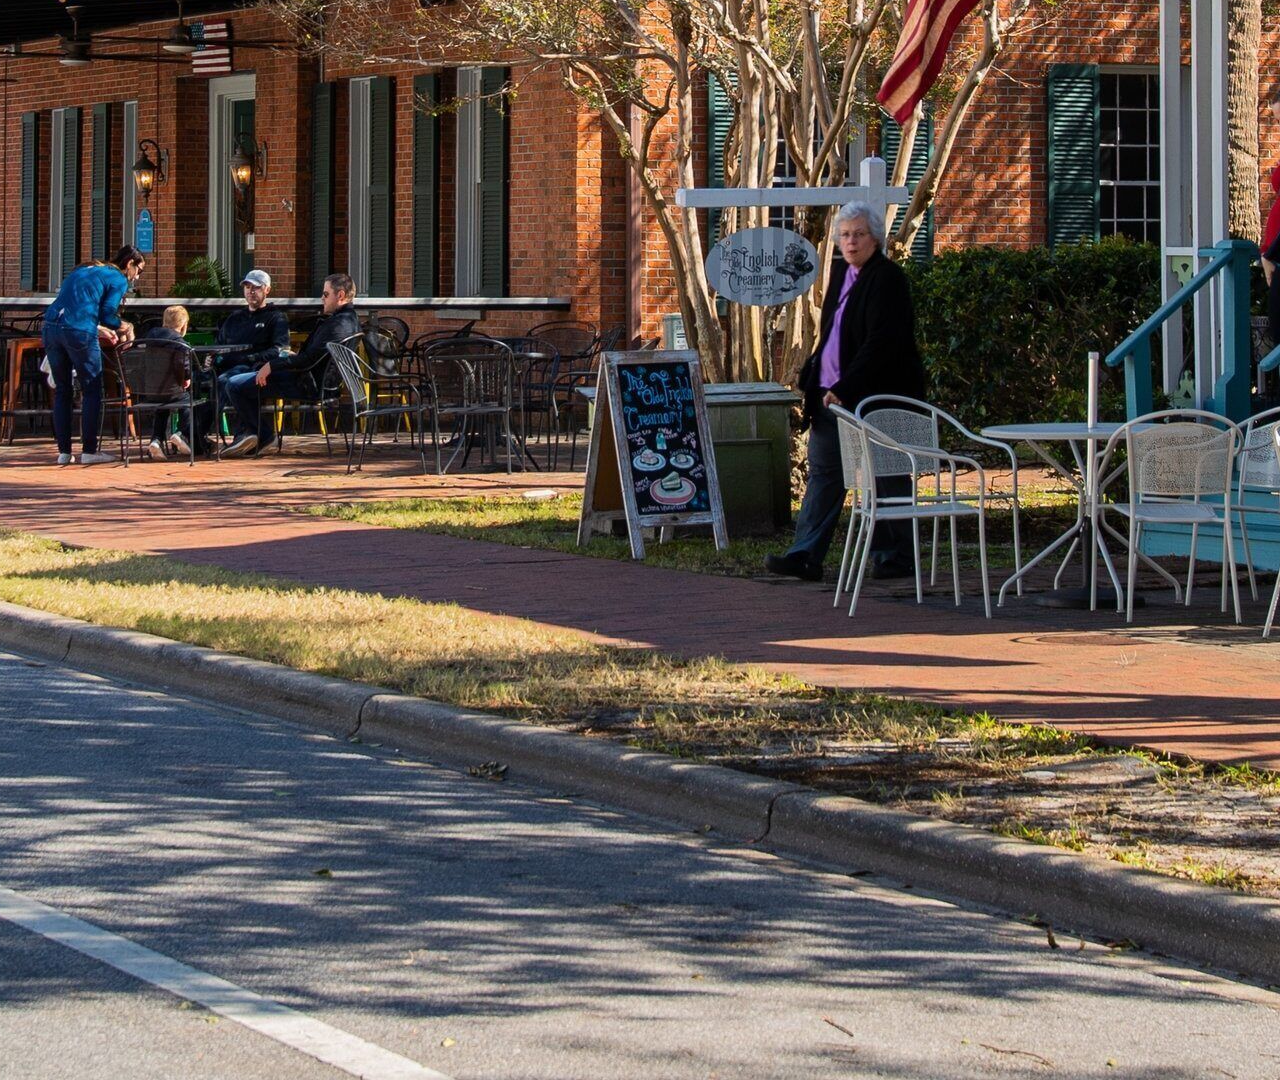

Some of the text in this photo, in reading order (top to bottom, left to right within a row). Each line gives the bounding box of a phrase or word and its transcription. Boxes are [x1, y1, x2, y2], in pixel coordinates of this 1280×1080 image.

[732, 247, 779, 273] English
[721, 270, 776, 293] Creamery
[622, 370, 694, 409] The Olde English
[624, 406, 682, 432] Creamery
